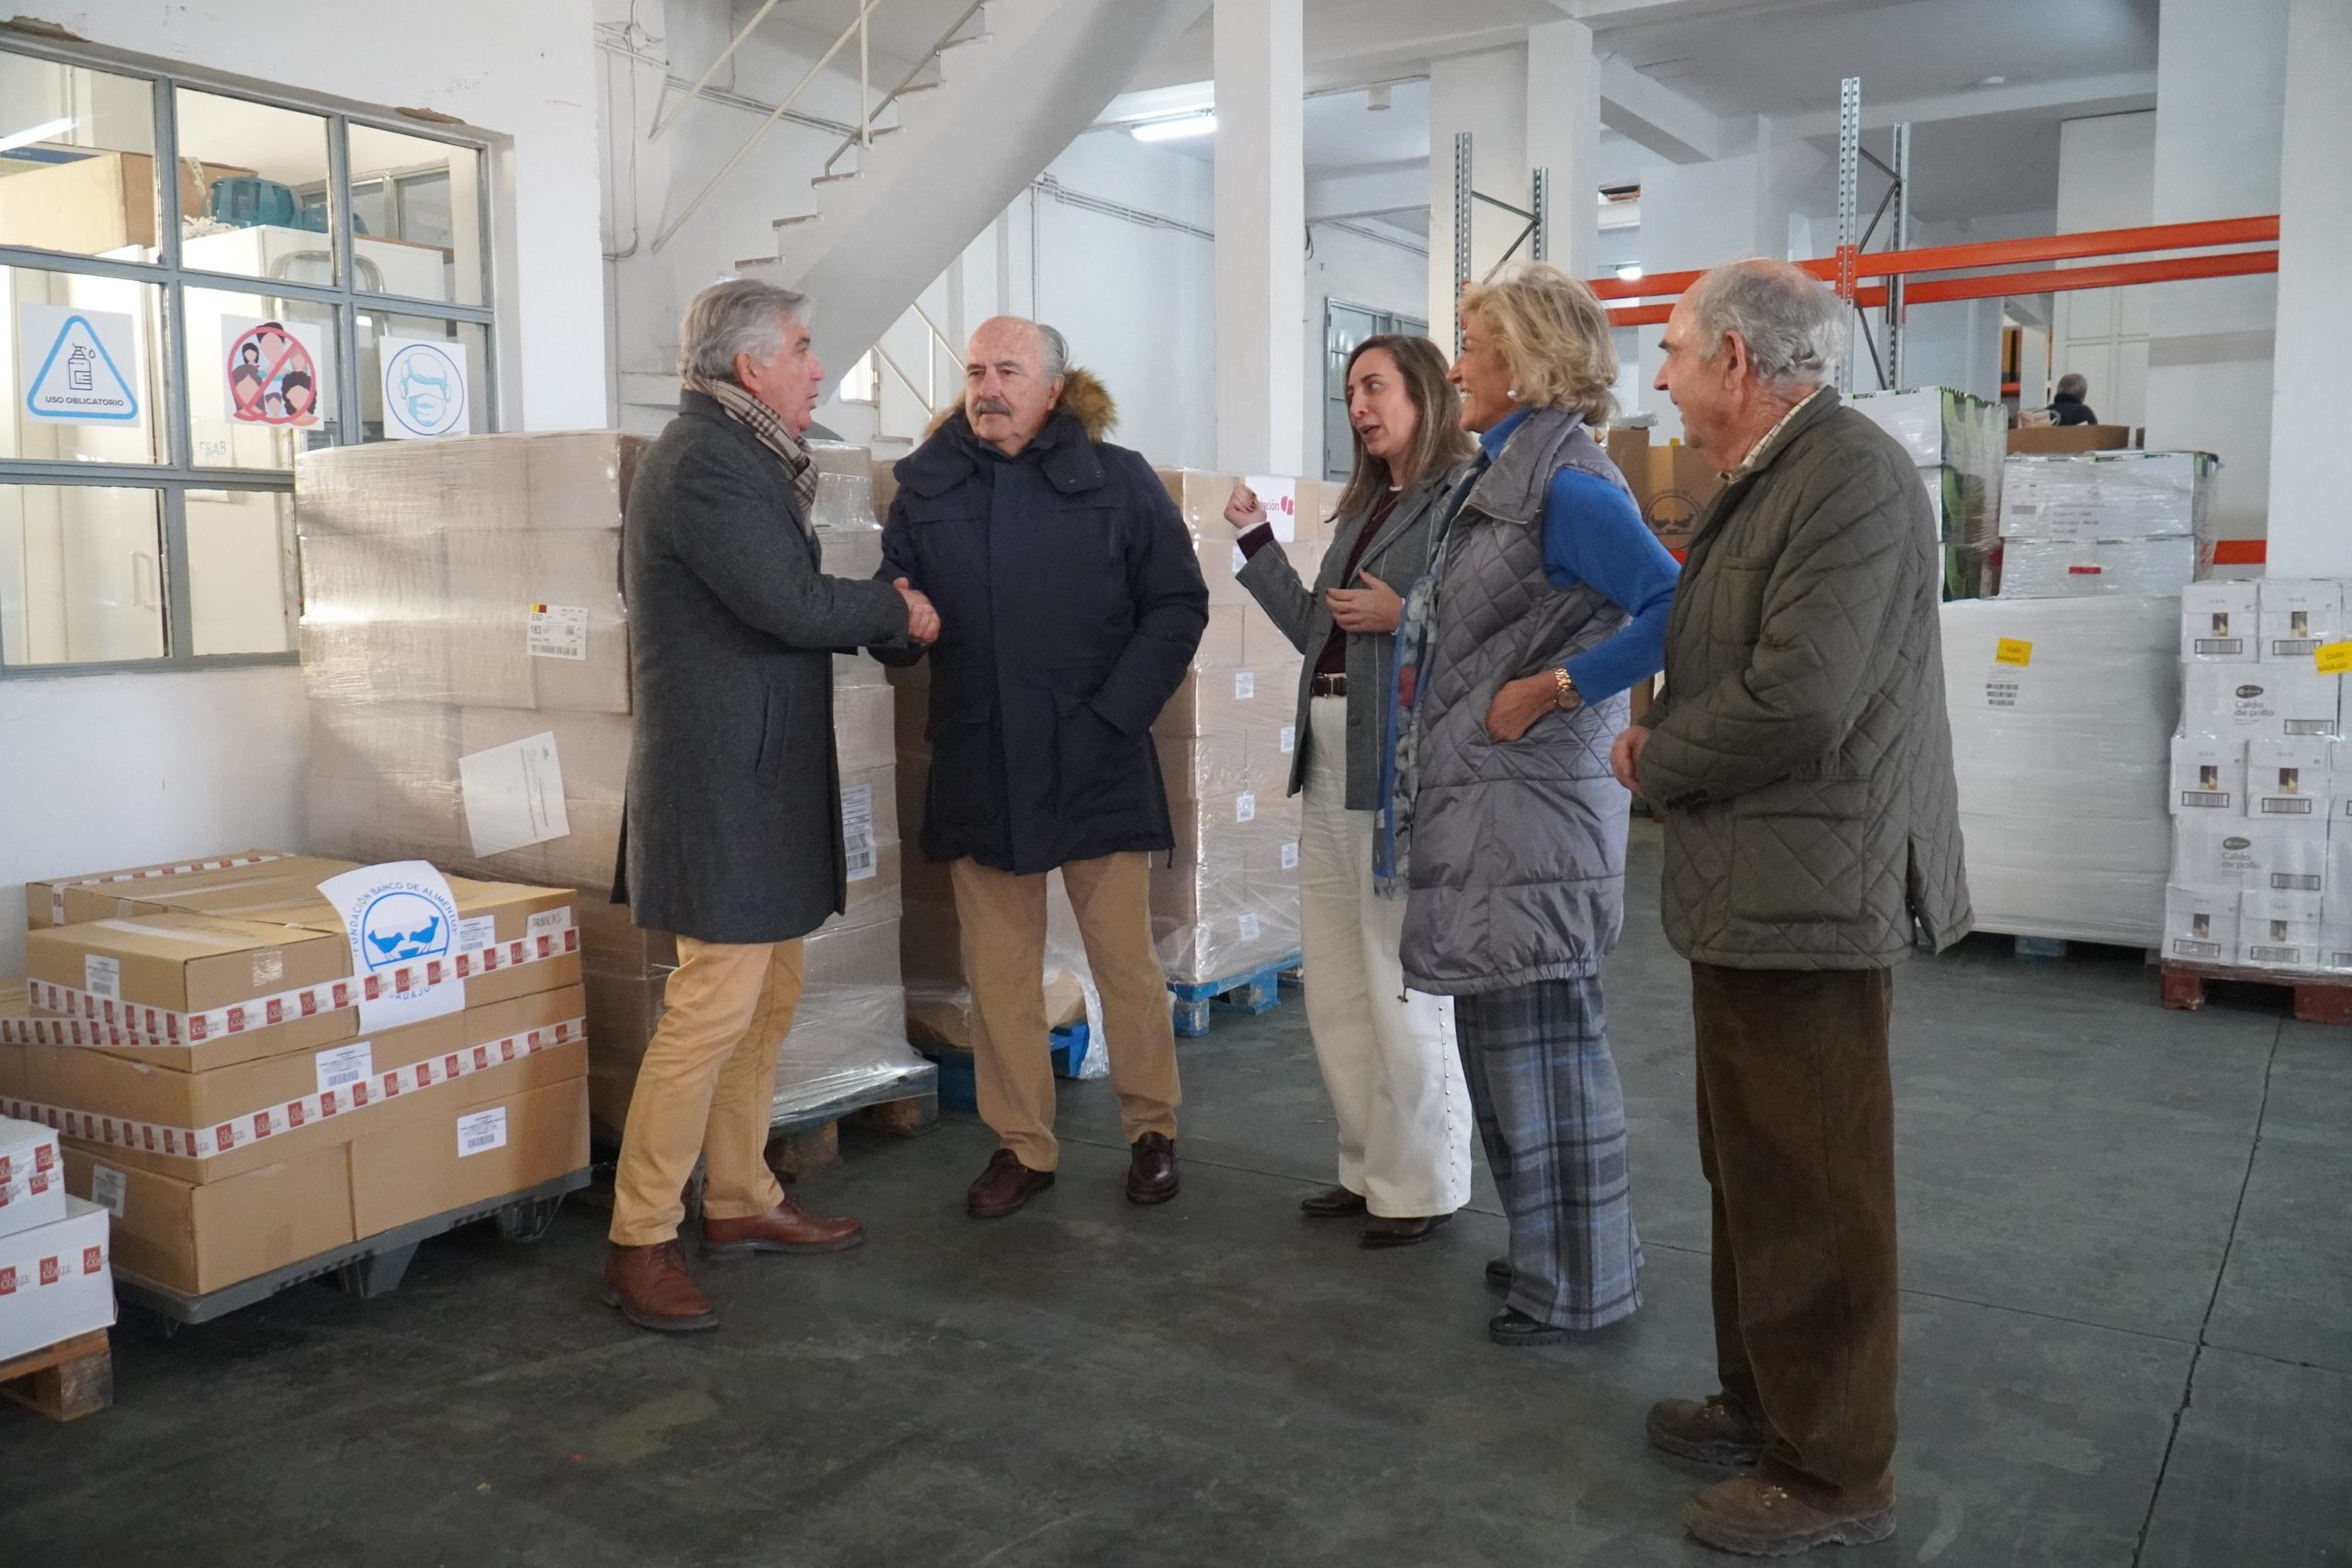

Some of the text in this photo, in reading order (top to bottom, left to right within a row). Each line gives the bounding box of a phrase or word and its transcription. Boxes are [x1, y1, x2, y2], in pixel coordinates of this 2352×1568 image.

[66, 397, 124, 406] OBLIGATORIO
[2249, 709, 2274, 717] pollo
[2222, 852, 2251, 861] Caldo
[369, 882, 403, 896] BANCO
[406, 883, 420, 891] DE
[423, 887, 458, 932] ALIMENTOS
